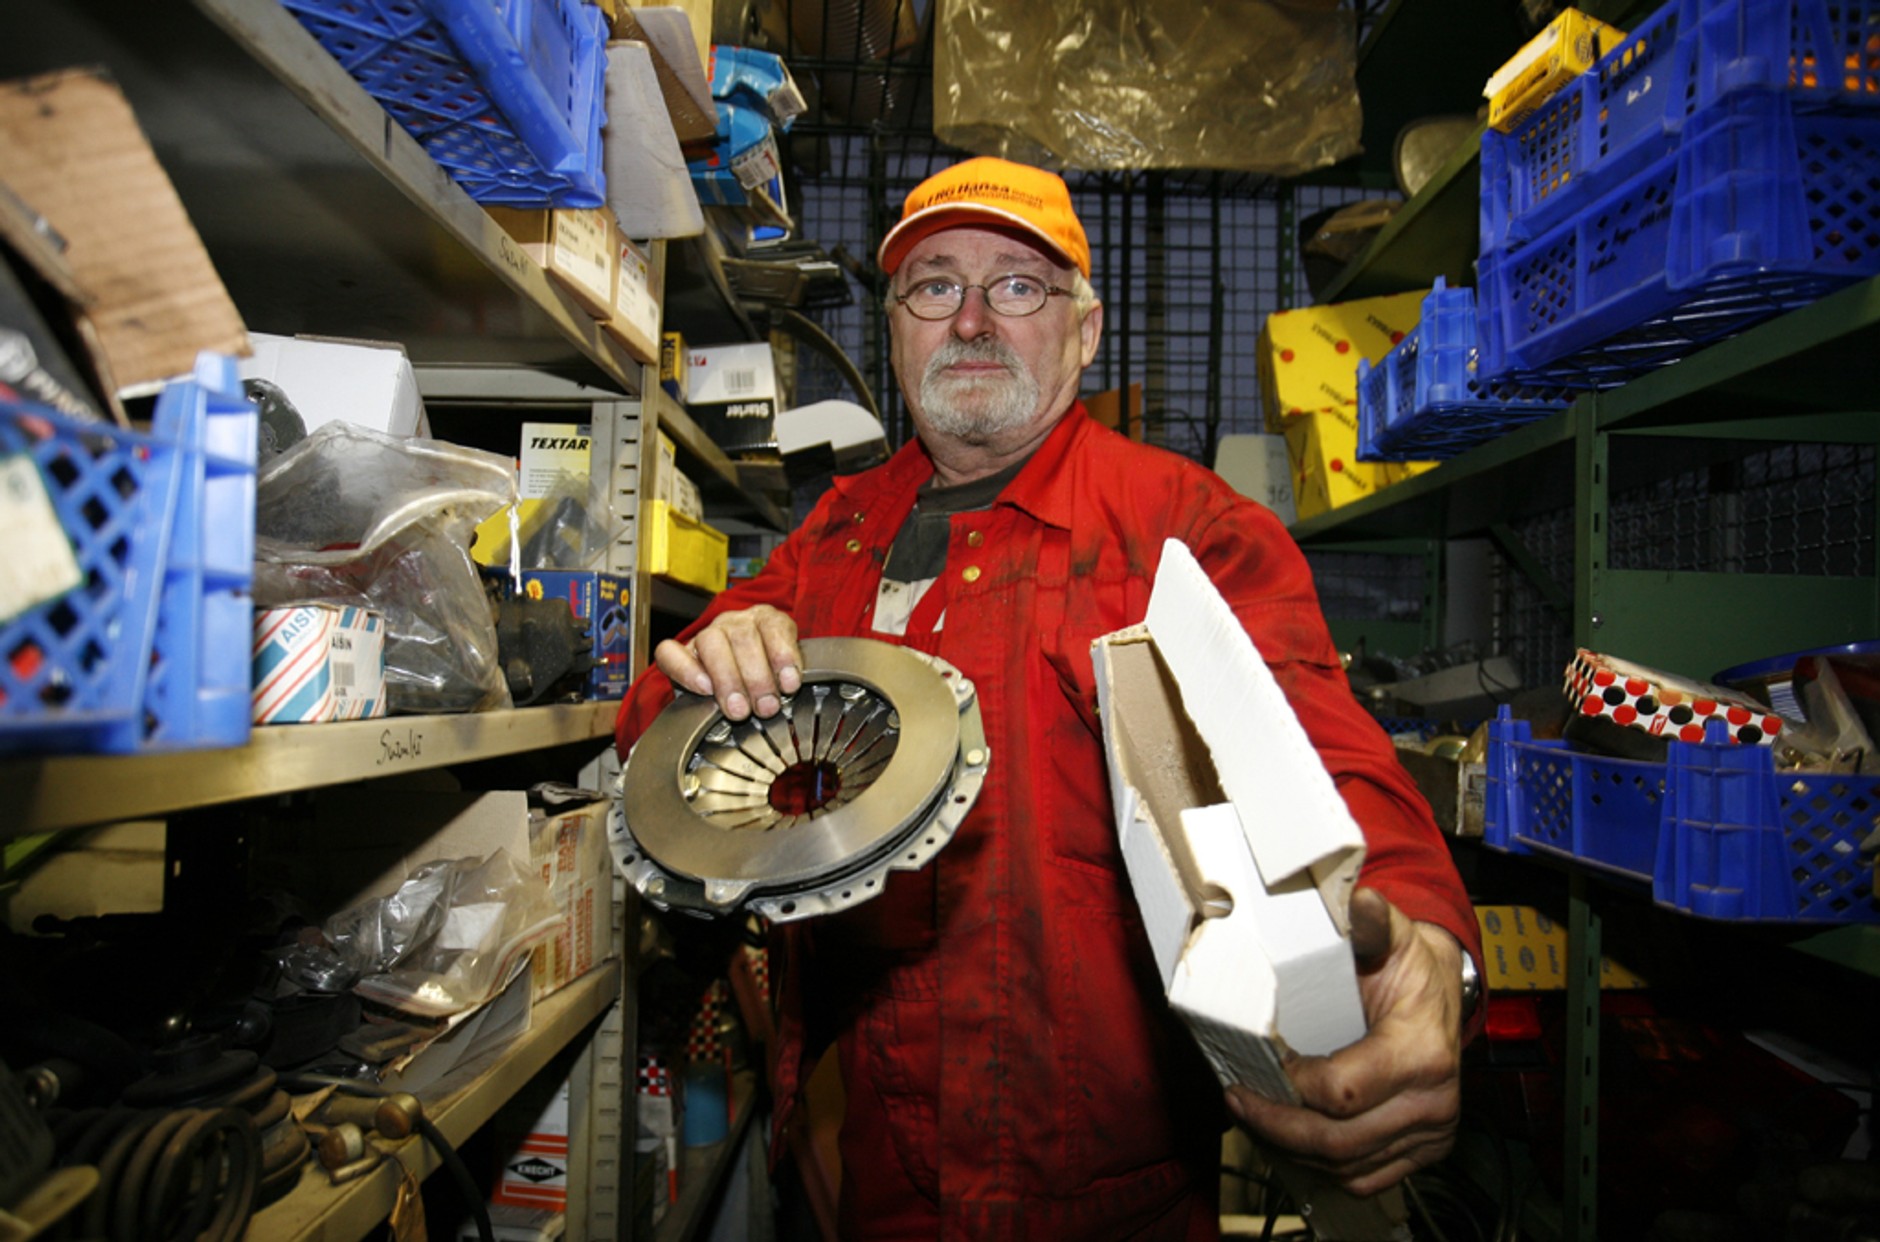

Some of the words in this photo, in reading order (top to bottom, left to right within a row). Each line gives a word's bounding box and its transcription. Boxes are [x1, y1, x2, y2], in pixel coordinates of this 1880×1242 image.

[726, 403, 769, 418] Starter
[530, 437, 589, 450] TEXTAR
[281, 607, 319, 643] AISI
[332, 637, 352, 650] AISIN
[517, 1164, 556, 1177] KNECHT
